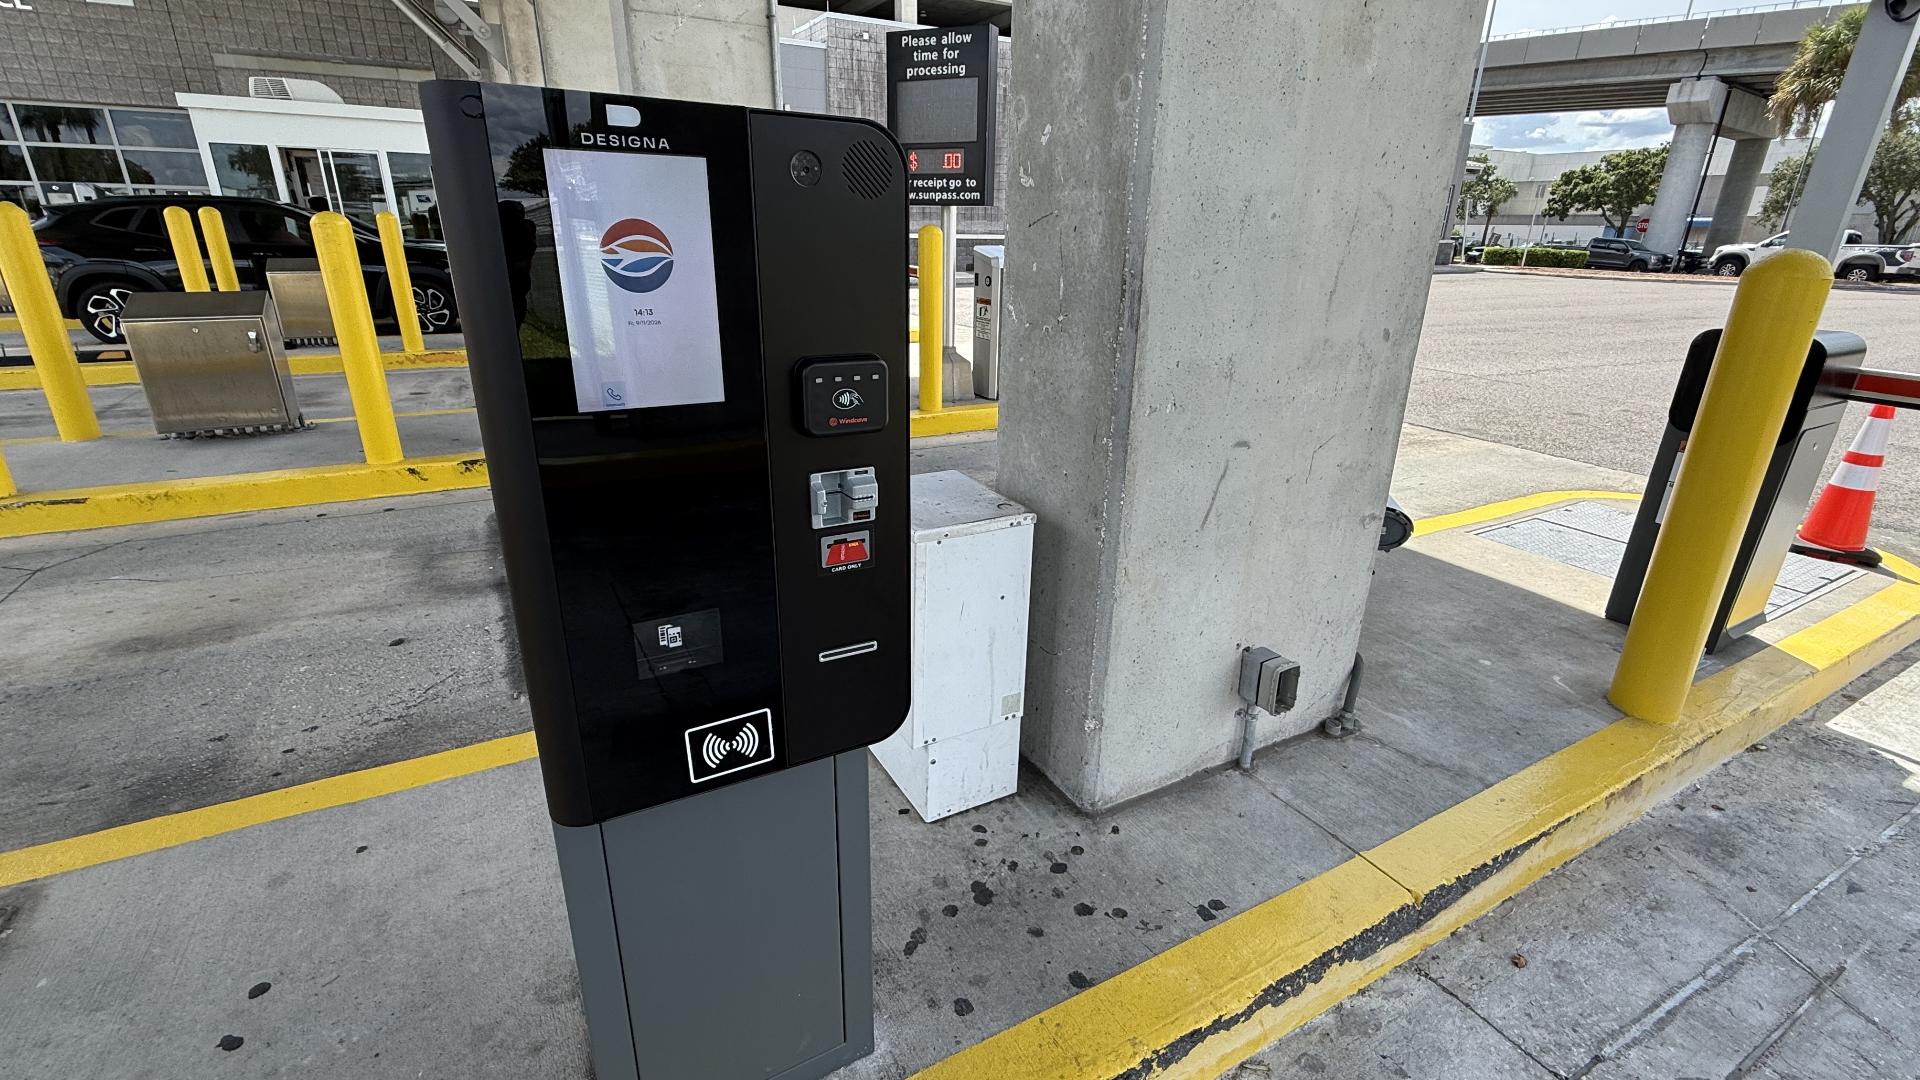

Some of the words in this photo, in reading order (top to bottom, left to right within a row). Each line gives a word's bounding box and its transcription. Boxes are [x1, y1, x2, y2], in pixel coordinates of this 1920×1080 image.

[901, 35, 937, 47] Please
[941, 32, 972, 45] allow
[913, 49, 939, 61] time
[942, 47, 960, 60] for
[906, 62, 966, 80] processing
[580, 132, 670, 150] DESIGNA
[913, 177, 947, 190] receipt
[949, 179, 962, 190] go
[965, 178, 977, 187] to
[909, 192, 981, 202] w.sunpass.com
[634, 308, 653, 317] 14:13
[831, 565, 847, 573] CARD
[847, 562, 862, 570] ONLY
